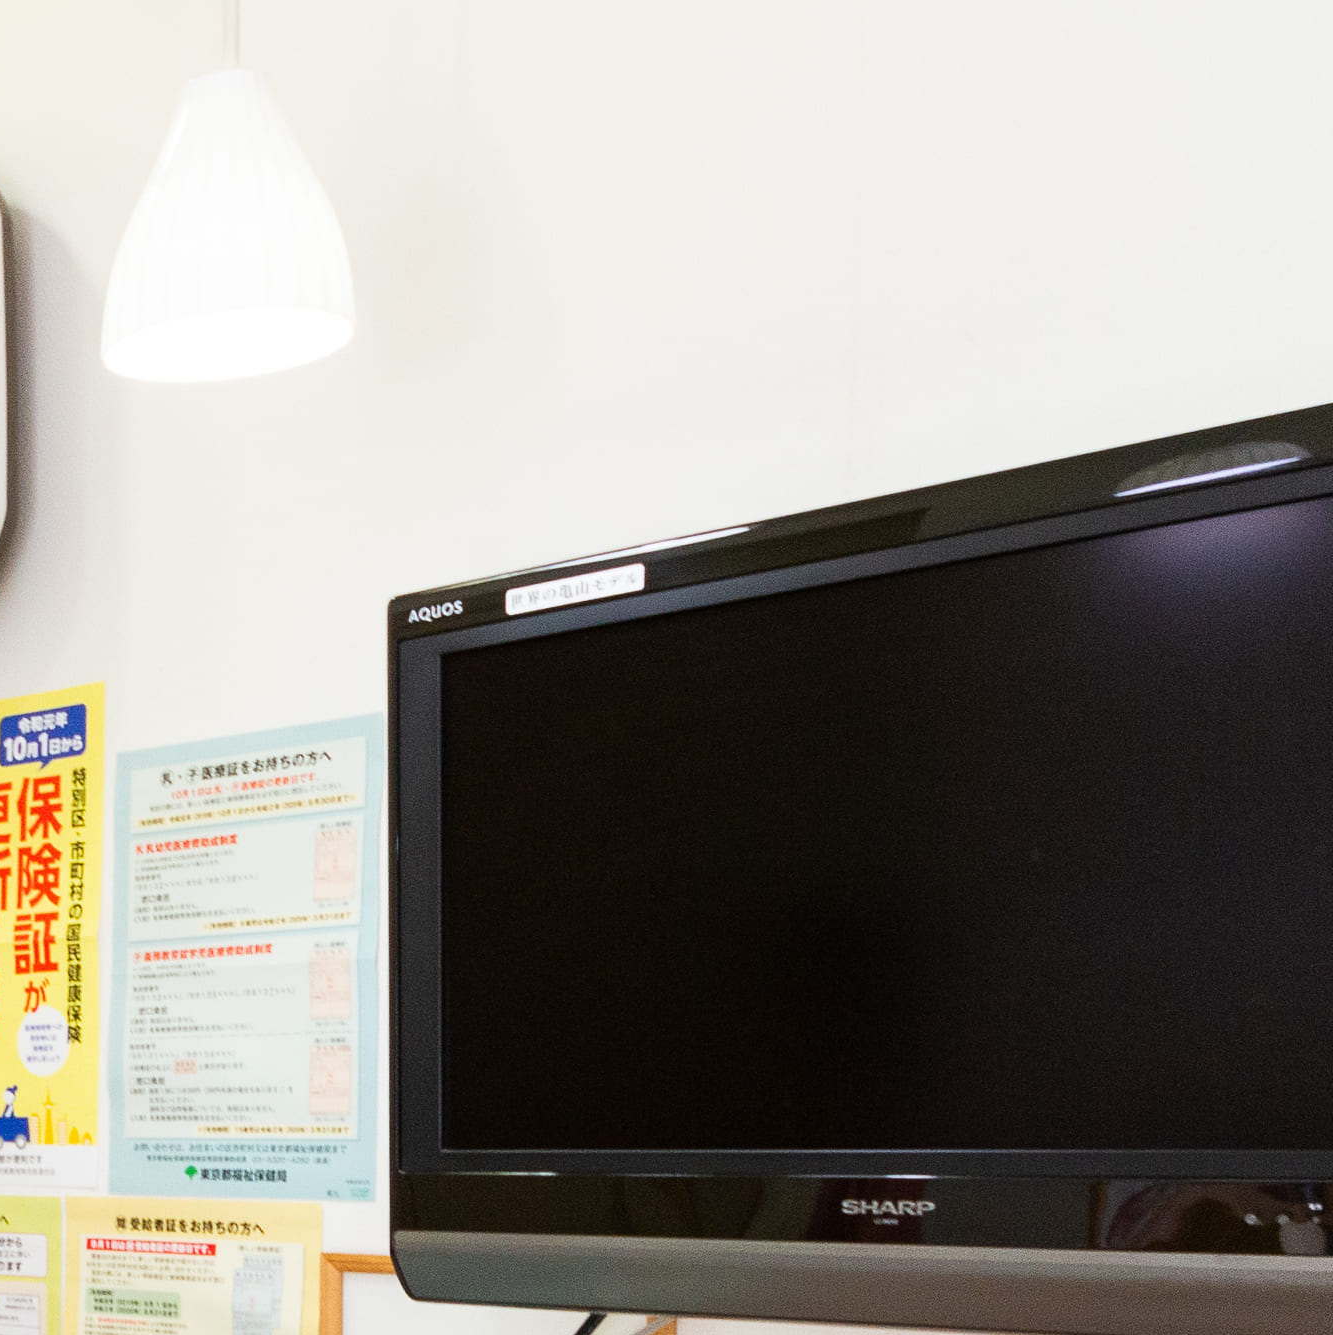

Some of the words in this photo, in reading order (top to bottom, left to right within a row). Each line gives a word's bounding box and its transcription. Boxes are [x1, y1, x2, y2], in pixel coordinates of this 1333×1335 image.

[407, 600, 464, 624] AQUOS
[18, 711, 68, 734] 令和元年
[3, 732, 84, 762] 10月1日から
[14, 774, 63, 1014] 保険証が
[67, 767, 88, 1044] 特別区・市町村の国民健康保険
[841, 1199, 935, 1217] SHARP
